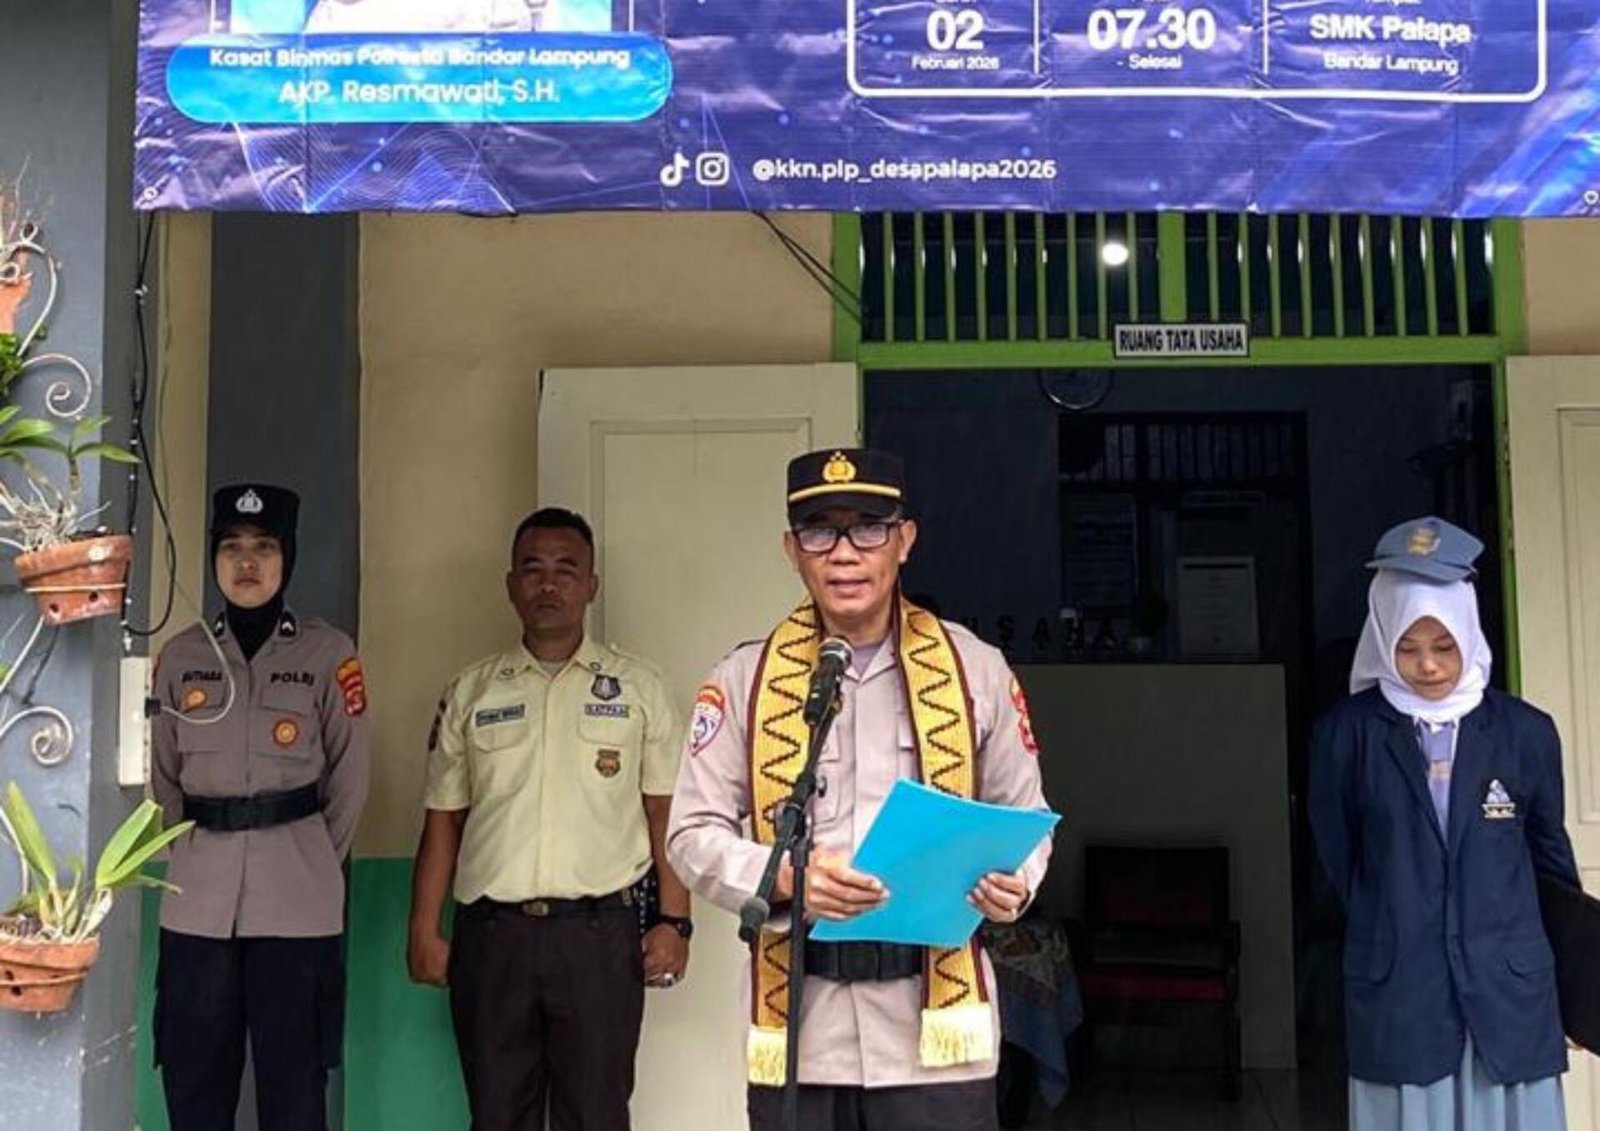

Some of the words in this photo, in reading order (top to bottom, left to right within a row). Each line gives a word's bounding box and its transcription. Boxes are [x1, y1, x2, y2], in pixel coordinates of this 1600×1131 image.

[927, 8, 984, 50] 02
[1087, 8, 1217, 50] 07.30
[1309, 13, 1376, 39] SMK
[1382, 15, 1472, 48] Palapa
[210, 48, 272, 67] Kasat
[276, 48, 354, 68] Binmas
[448, 47, 525, 66] Bandar
[529, 48, 631, 70] Lampung
[911, 55, 965, 70] Februari
[966, 56, 1000, 70] 2026
[1128, 53, 1183, 69] Selesai
[1324, 51, 1383, 70] Bandar
[1386, 54, 1459, 75] Lampung
[513, 79, 561, 103] S.H.
[752, 157, 1058, 183] @kkn.plp_desapalapa2026
[1119, 330, 1164, 351] RUANG
[1166, 329, 1197, 351] TATA
[1200, 329, 1244, 350] USAHA
[270, 671, 315, 687] POLRI
